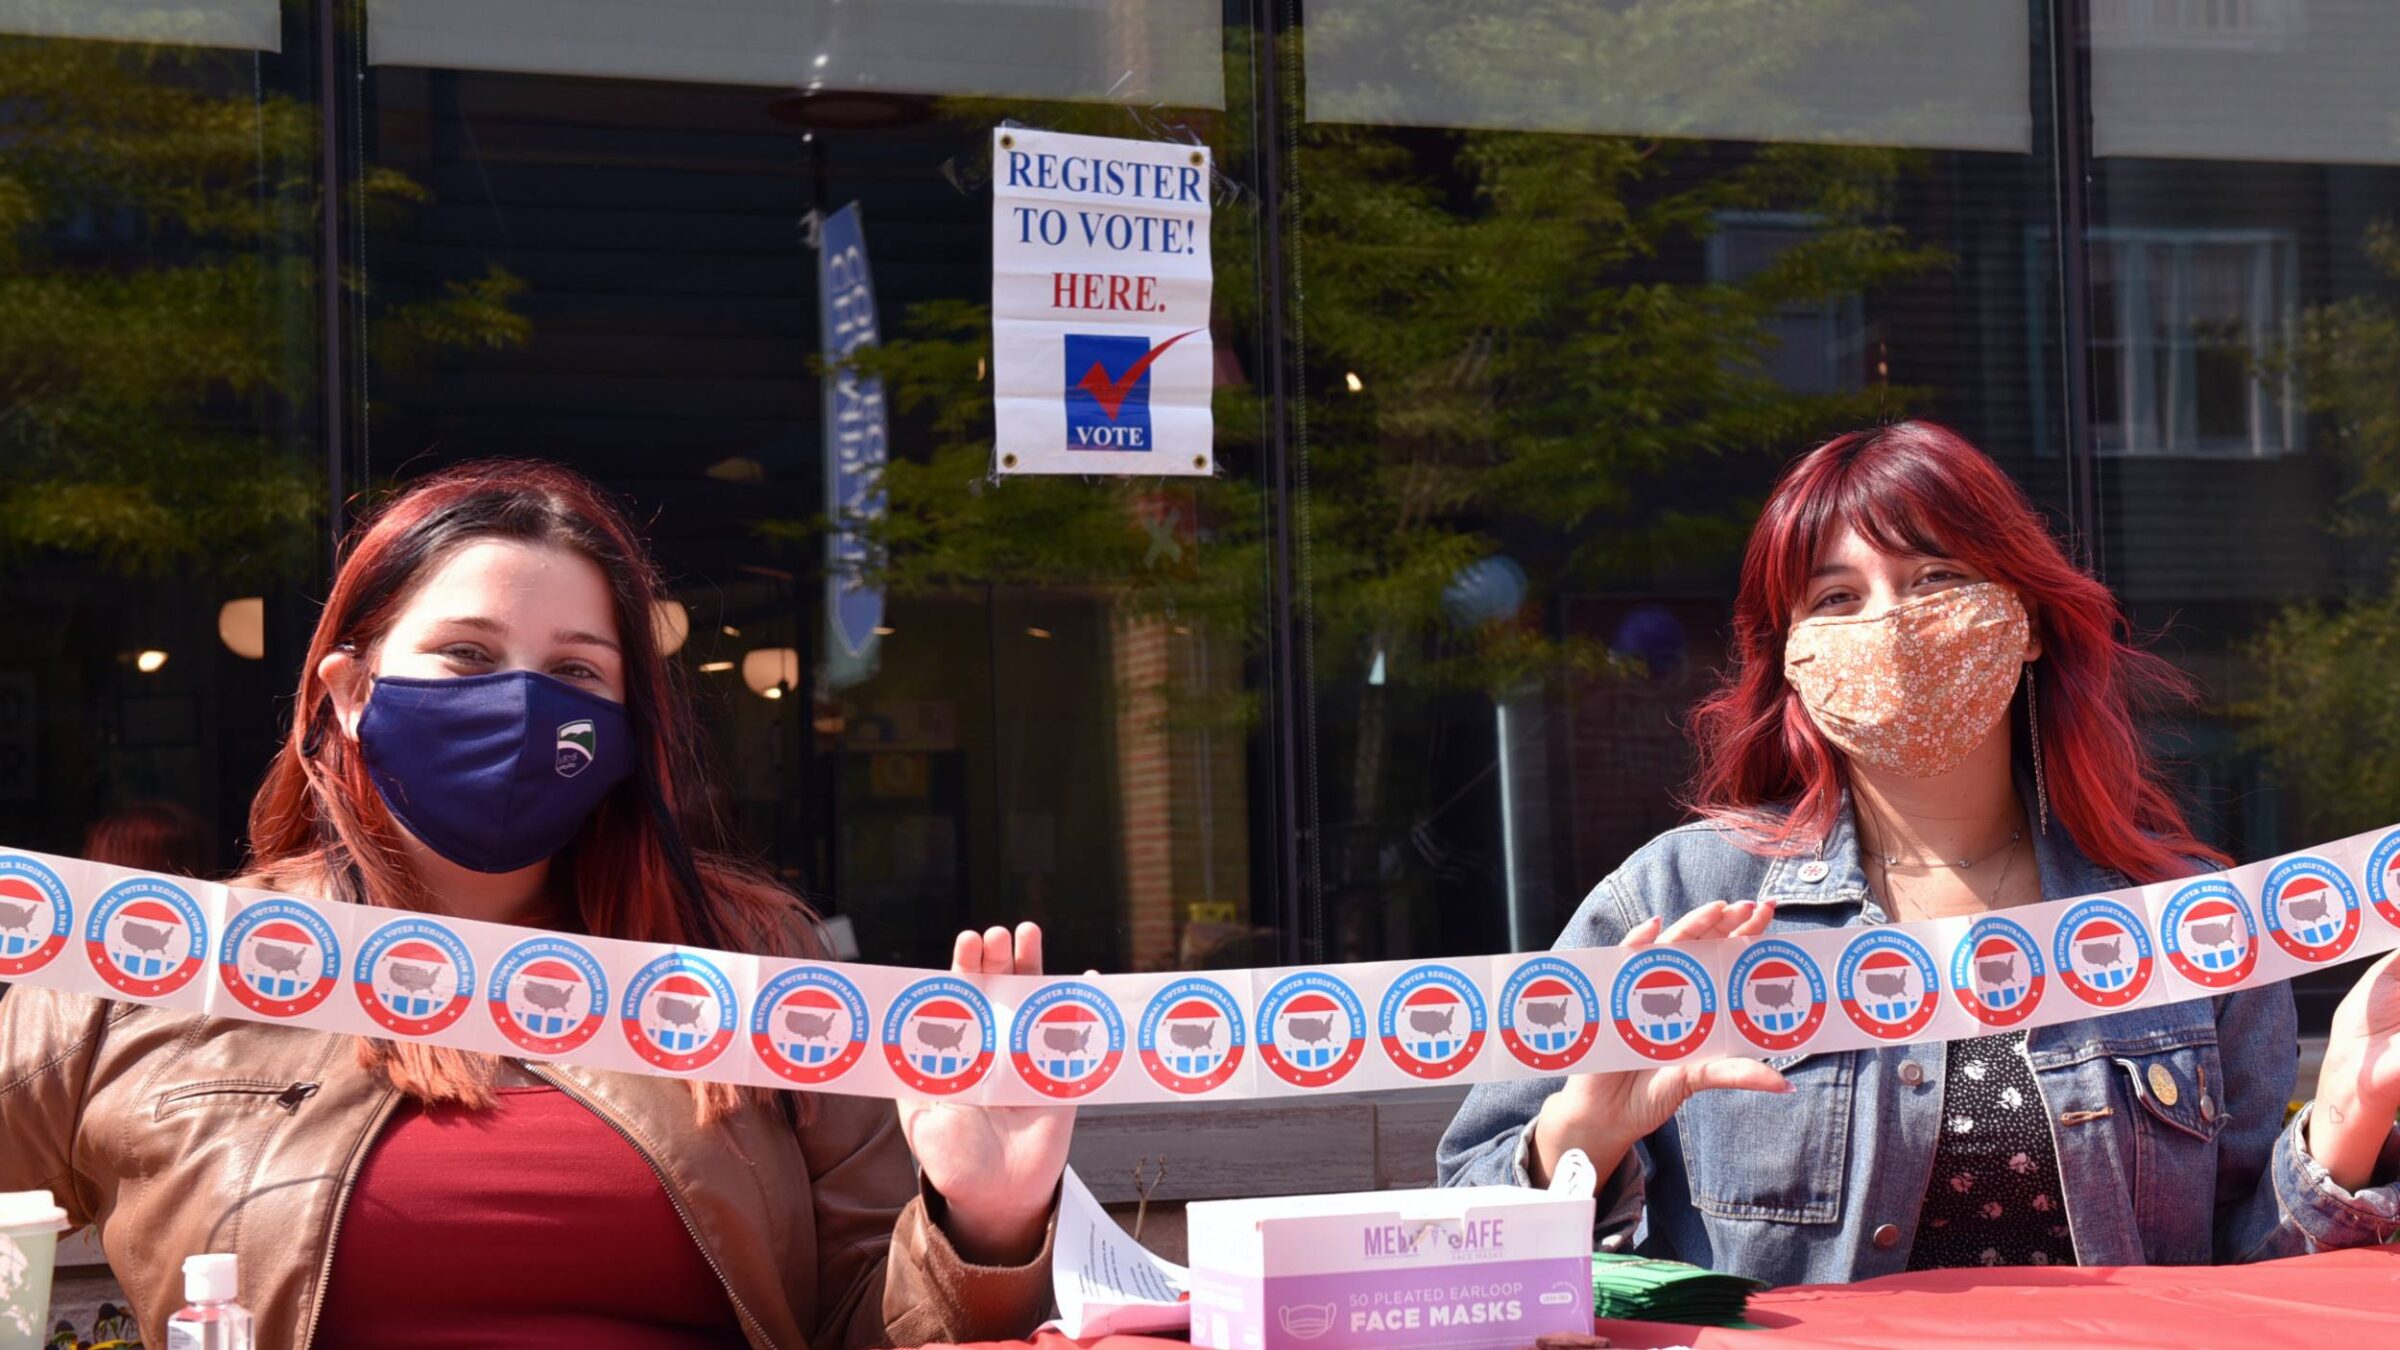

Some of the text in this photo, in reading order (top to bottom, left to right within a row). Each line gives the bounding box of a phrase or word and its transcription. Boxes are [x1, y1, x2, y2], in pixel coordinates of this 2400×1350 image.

[1008, 151, 1203, 202] REGISTER
[1013, 207, 1195, 255] TO VOTE!
[1052, 272, 1166, 313] HERE.
[1076, 426, 1144, 447] VOTE
[15, 862, 66, 932] REGISTRATION DAY
[2266, 862, 2356, 928] NATIONAL VOTER REGISTRATION DAY
[2372, 857, 2382, 899] NATIONAL
[92, 884, 202, 955] NATIONAL VOTER REGISTRATION DAY
[225, 906, 335, 975] NATIONAL VOTER REGISTRATION DAY
[2058, 906, 2148, 968] NATIONAL VOTER REGISTRATION DAY
[2166, 909, 2178, 949] NATIONAL
[2176, 889, 2200, 906] VOTER
[360, 938, 384, 979] NATIONAL
[384, 925, 415, 938] VOTER
[418, 926, 468, 972] REGISTRATION
[494, 944, 603, 1014] NATIONAL VOTER REGISTRATION DAY
[1733, 945, 1822, 1007] NATIONAL VOTER REGISTRATION DAY
[1842, 936, 1934, 996] NATIONAL VOTER REGISTRATION DAY
[1956, 944, 1970, 986] NATIONAL
[1987, 923, 2034, 954] REGISTRATION
[2032, 956, 2041, 974] DAY
[628, 973, 652, 1016] NATIONAL
[724, 1008, 732, 1030] DAY
[756, 973, 864, 1041] NATIONAL VOTER REGISTRATION DAY
[888, 998, 912, 1041] NATIONAL
[911, 984, 940, 998] VOTER
[943, 983, 991, 1027] REGISTRATION
[1144, 1003, 1162, 1046] NATIONAL
[1162, 985, 1188, 1002] VOTER
[1190, 984, 1238, 1022] REGISTRATION
[1261, 998, 1279, 1041] NATIONAL
[1277, 979, 1304, 996] VOTER
[1306, 978, 1358, 1015] REGISTRATION
[1384, 971, 1483, 1033] NATIONAL VOTER REGISTRATION DAY
[1503, 963, 1596, 1026] NATIONAL VOTER REGISTRATION DAY
[1616, 954, 1714, 1016] NATIONAL VOTER REGISTRATION DAY
[1015, 988, 1121, 1050] NATIONAL VOTER REGISTRATION DAY
[1350, 1294, 1368, 1307] 50
[1374, 1288, 1444, 1305] PLEATED
[1450, 1282, 1523, 1300] EARLOOP
[1351, 1300, 1523, 1333] FACE MASKS
